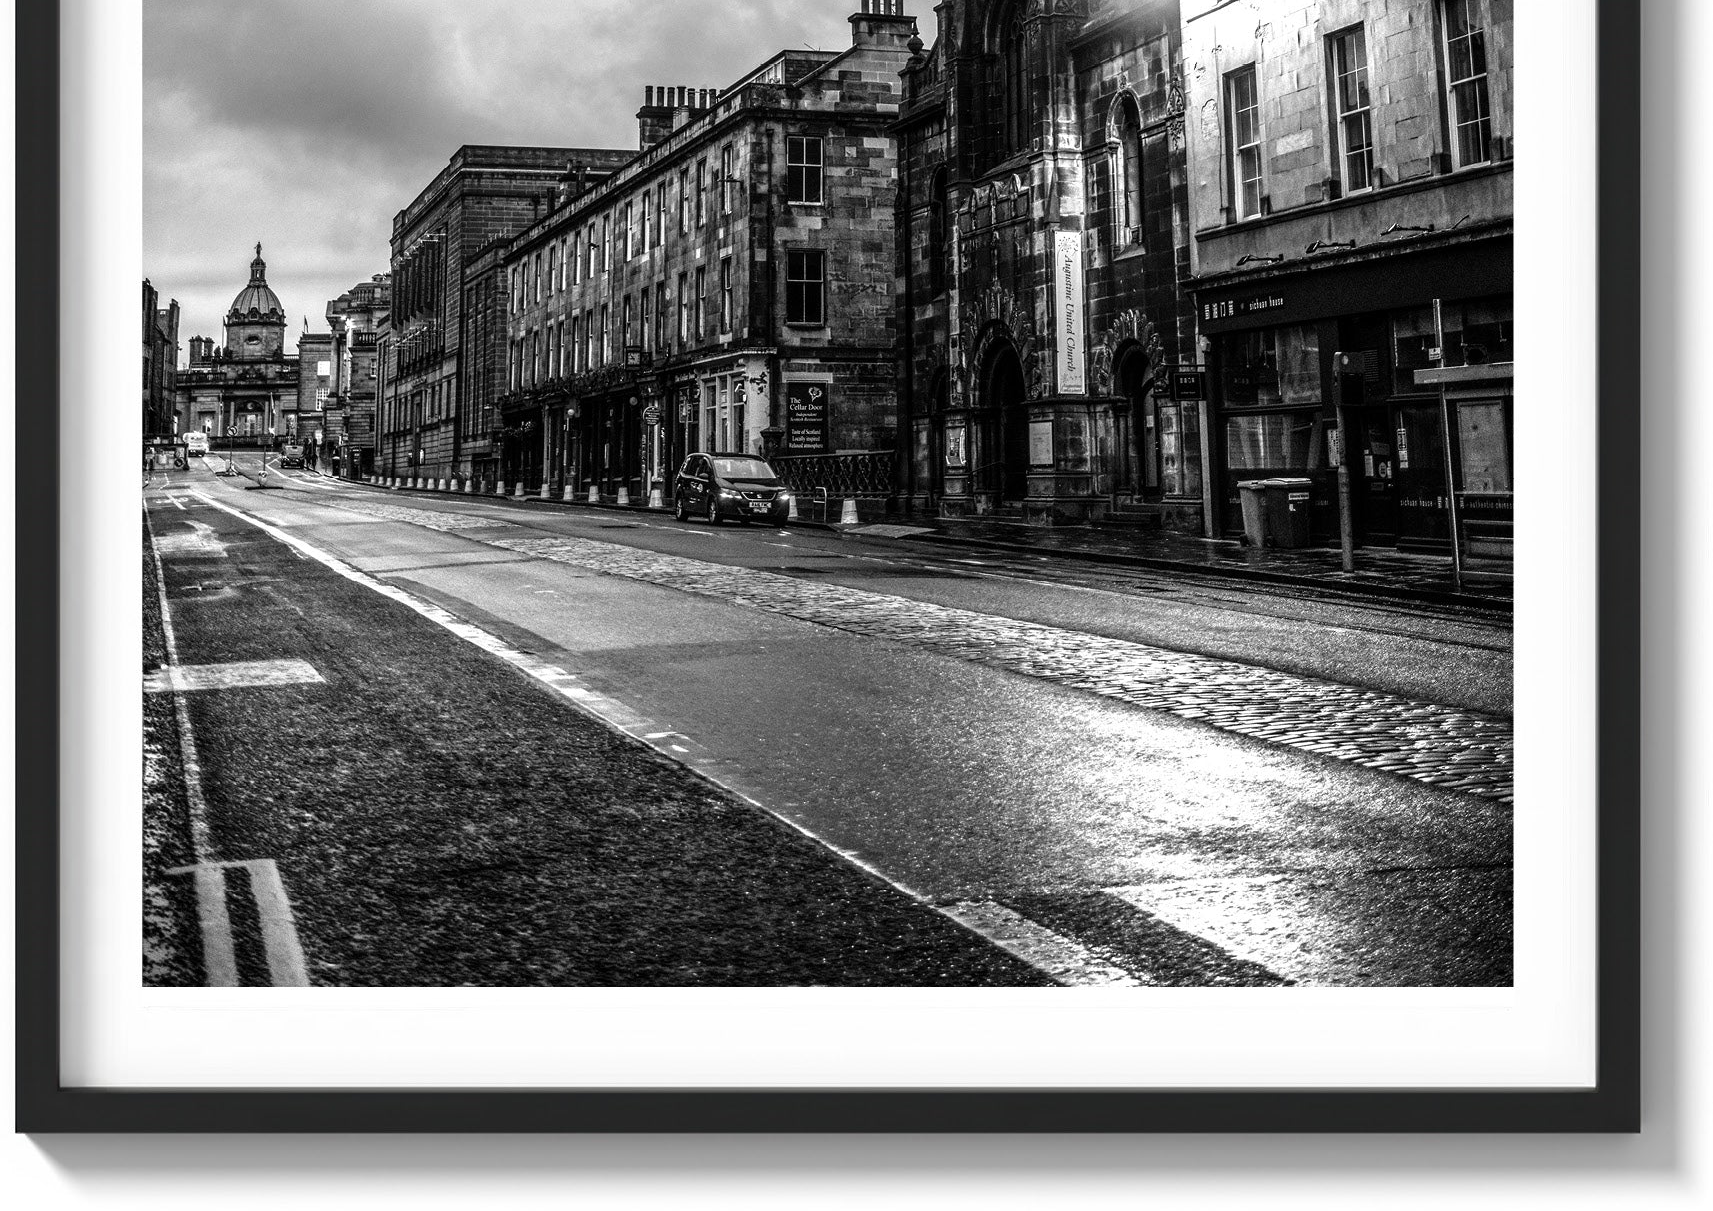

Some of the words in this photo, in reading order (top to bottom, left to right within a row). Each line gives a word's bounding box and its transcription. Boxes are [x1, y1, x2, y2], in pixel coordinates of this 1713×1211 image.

[1062, 255, 1075, 301] Augustine
[1268, 295, 1284, 307] house
[1066, 303, 1075, 335] United
[1066, 337, 1076, 372] Church
[789, 403, 807, 411] Cellar
[808, 403, 823, 411] Door
